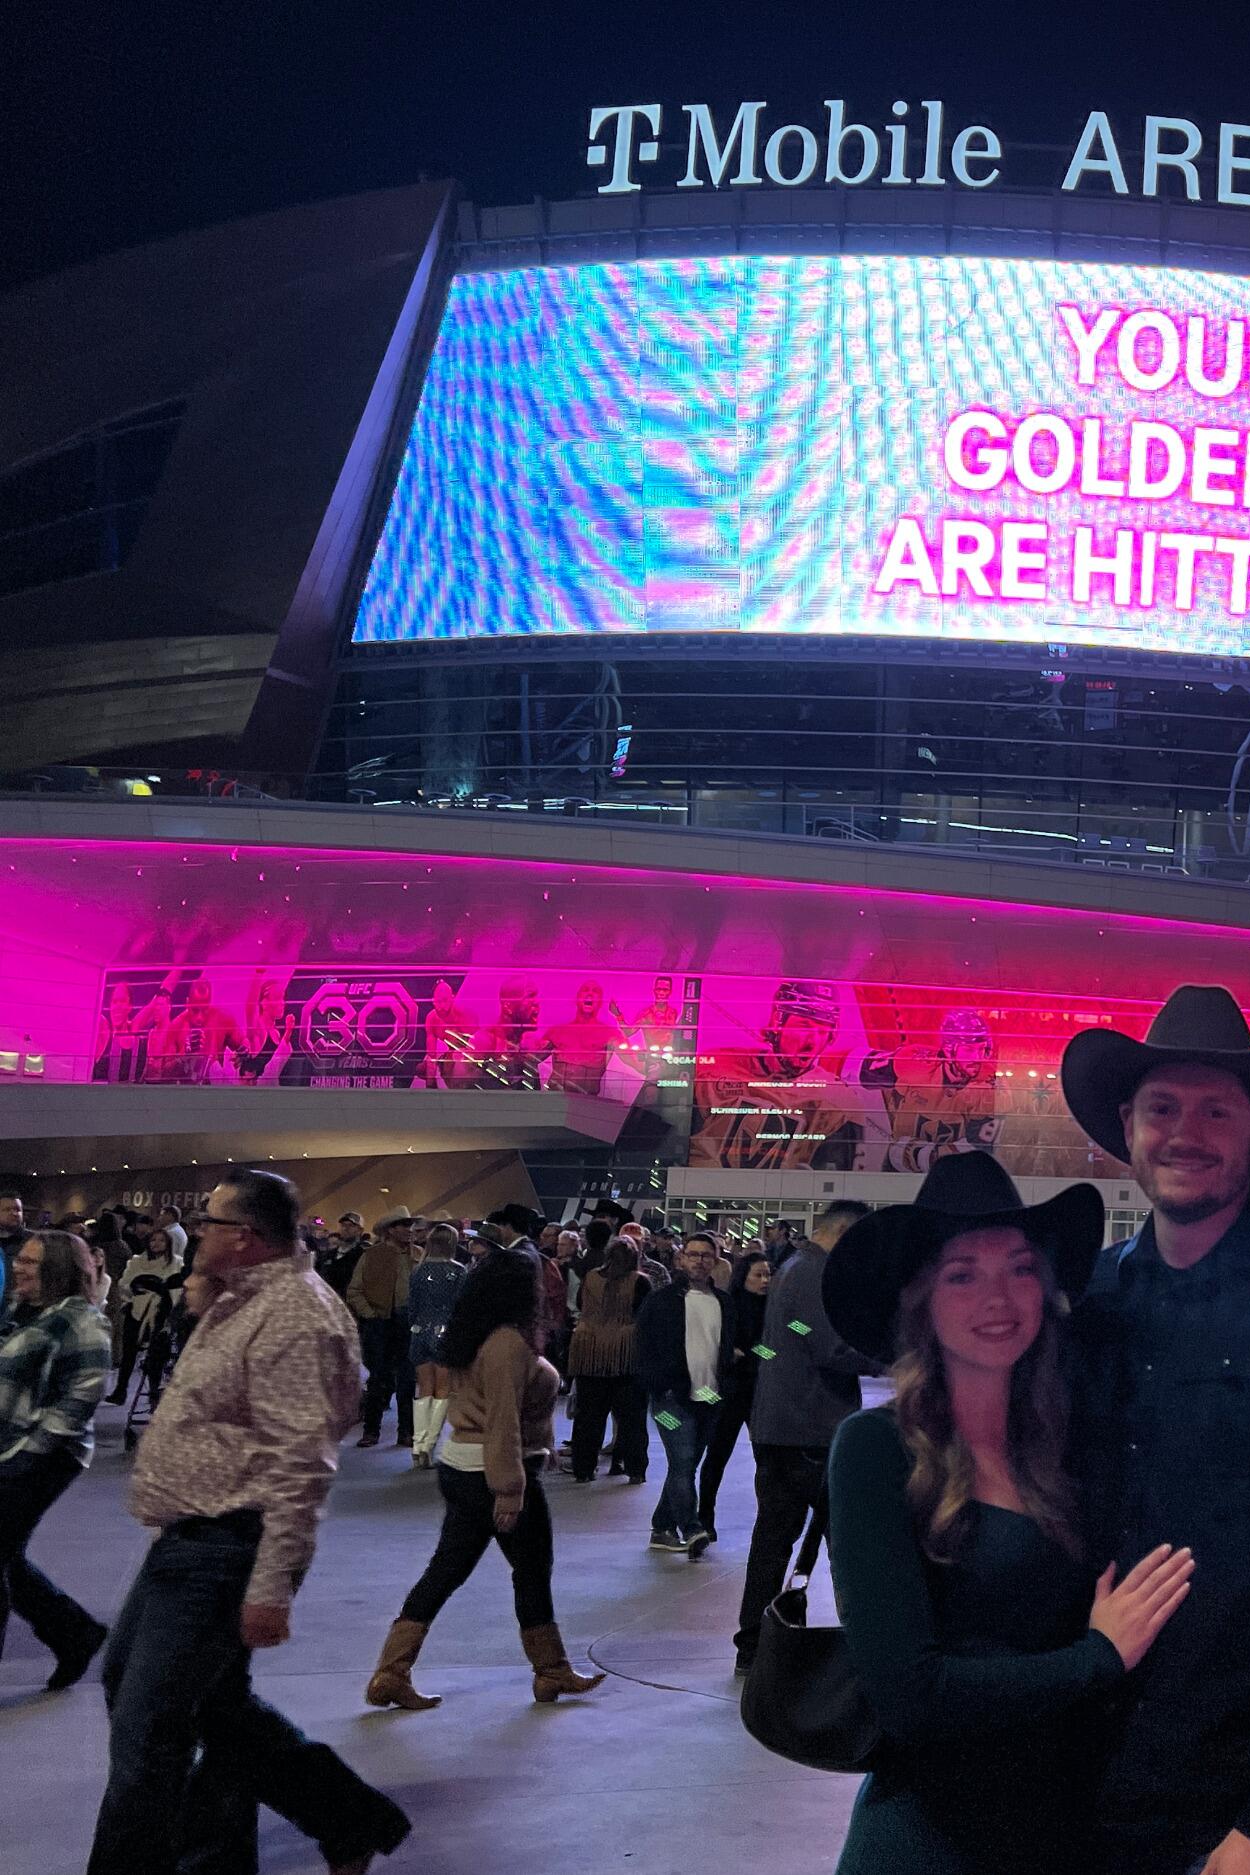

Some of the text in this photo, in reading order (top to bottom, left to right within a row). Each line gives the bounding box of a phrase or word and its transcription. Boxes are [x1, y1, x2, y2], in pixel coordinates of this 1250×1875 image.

[676, 99, 1002, 190] Mobile
[873, 517, 1049, 600] ARE
[348, 983, 373, 995] UFC
[313, 996, 407, 1056] 30
[310, 1075, 394, 1089] CHANGING THE GAME
[122, 1191, 211, 1208] BOX OFFI
